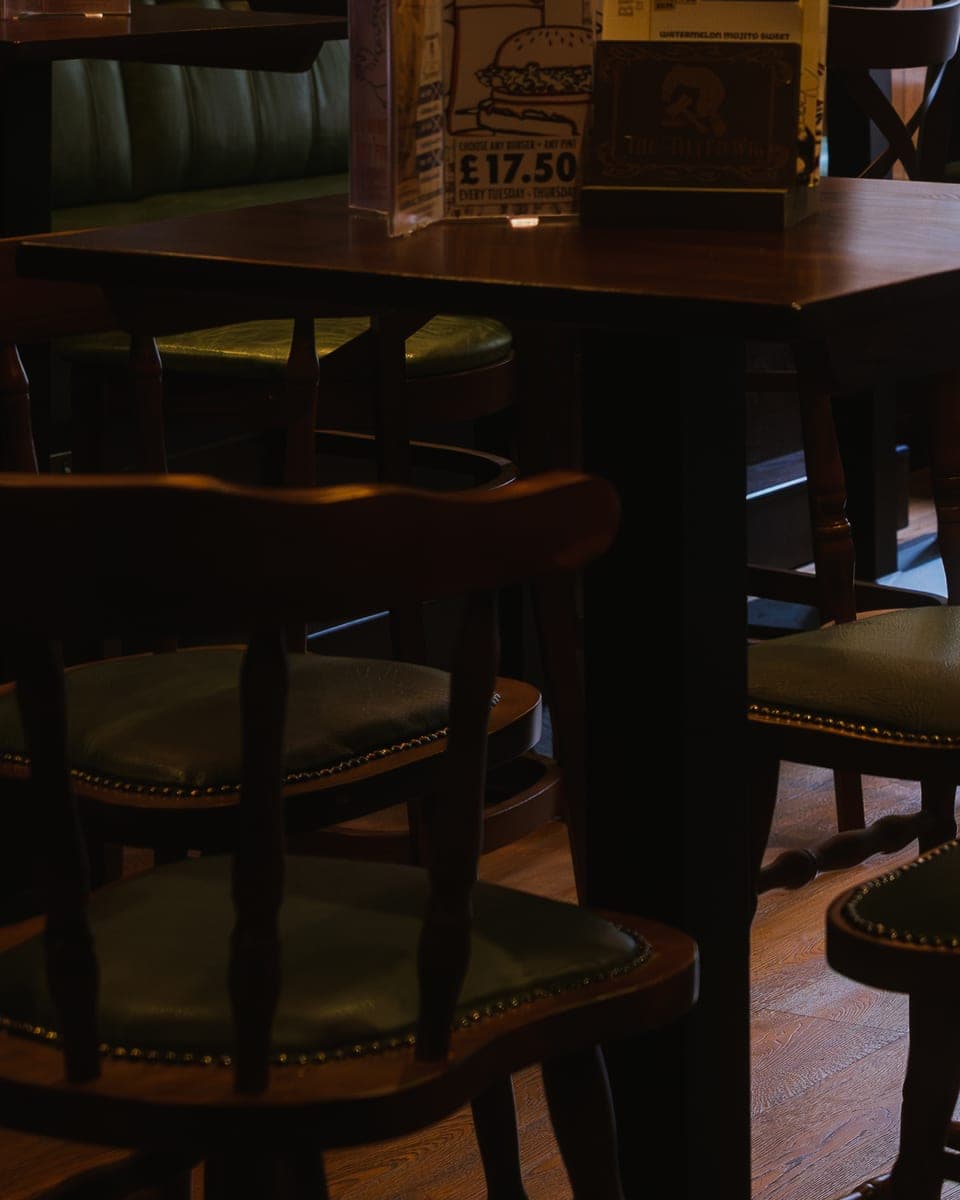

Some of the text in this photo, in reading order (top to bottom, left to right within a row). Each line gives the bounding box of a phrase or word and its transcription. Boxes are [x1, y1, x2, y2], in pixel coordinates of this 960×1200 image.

[460, 153, 578, 185] £17.50
[460, 189, 485, 201] EVERY
[488, 187, 525, 200] TUESDAY
